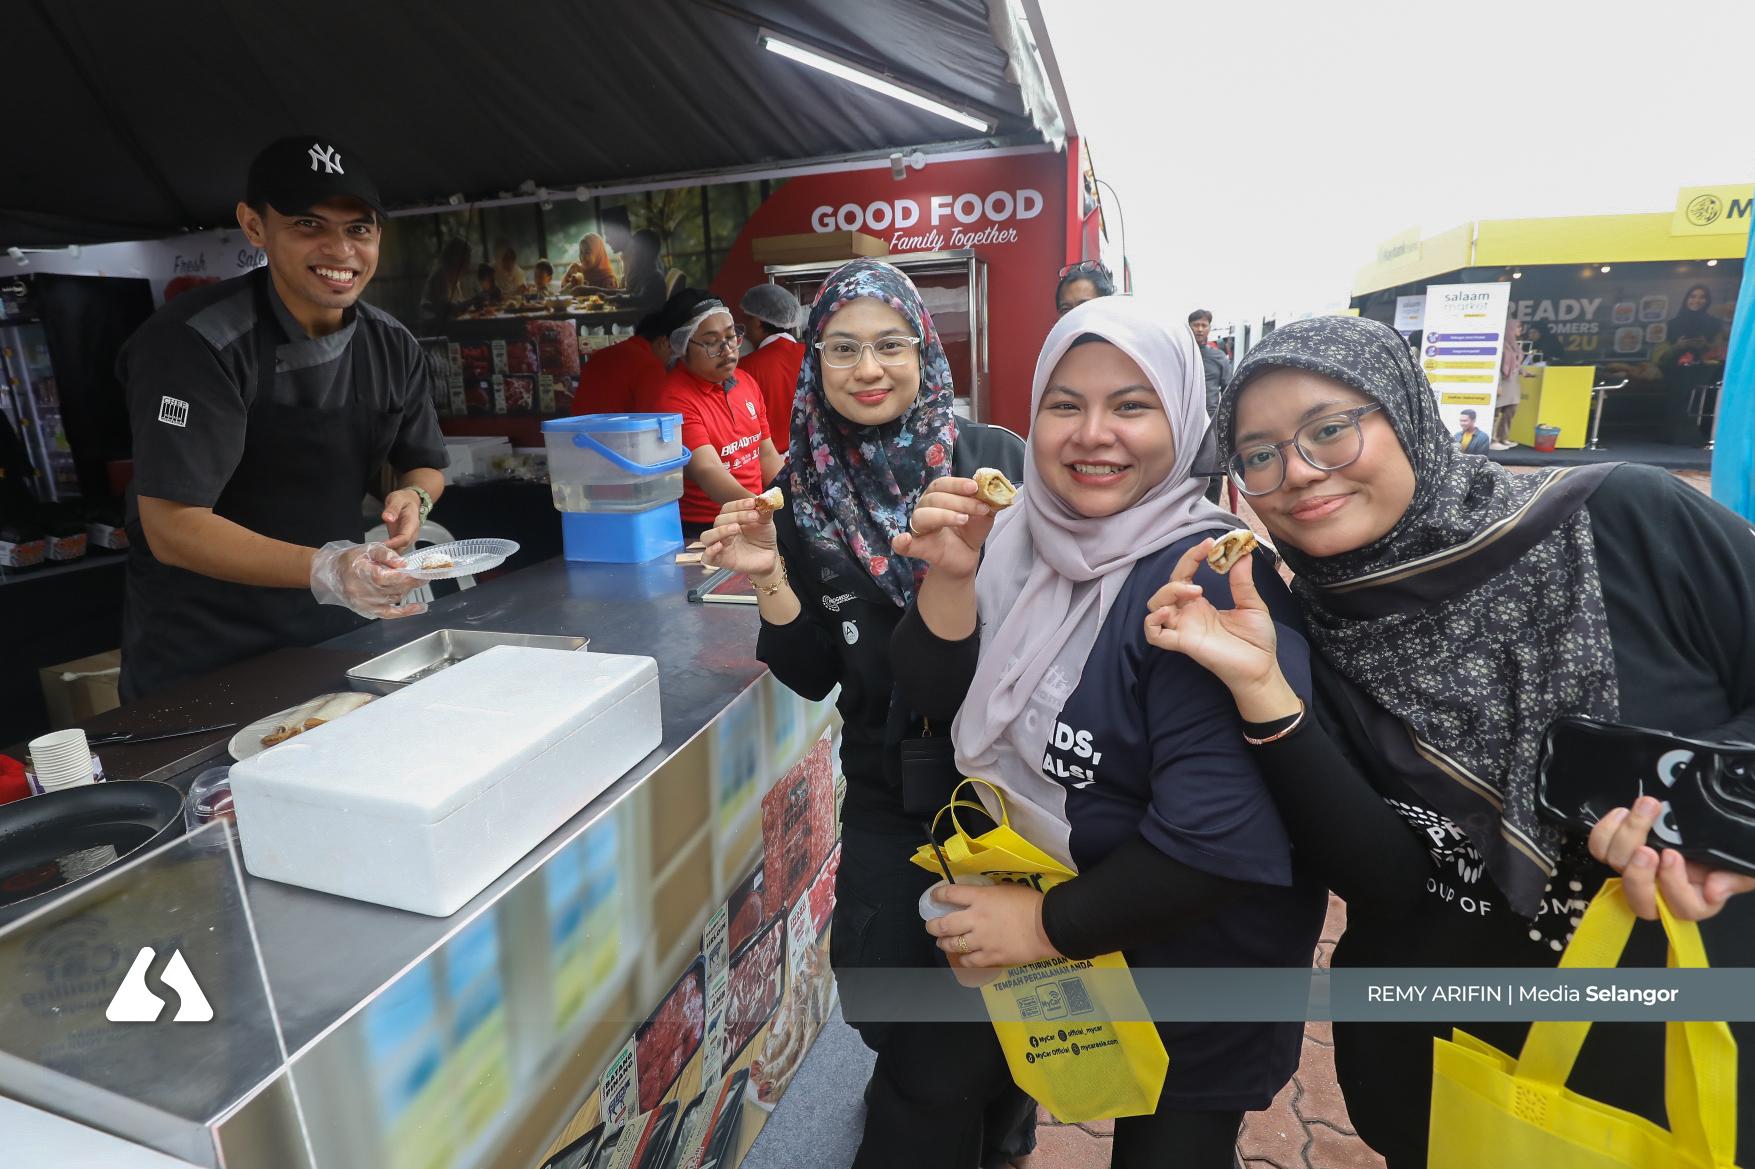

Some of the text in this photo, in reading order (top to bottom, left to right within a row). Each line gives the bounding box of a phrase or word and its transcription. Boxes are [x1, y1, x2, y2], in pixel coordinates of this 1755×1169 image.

[307, 143, 345, 175] NY
[811, 189, 1044, 233] GOOD FOOD
[890, 224, 1018, 252] Family Together
[173, 250, 207, 274] Fresh
[236, 247, 268, 268] Safe
[1444, 291, 1490, 302] salaam
[1460, 896, 1492, 916] OF
[993, 960, 1094, 992] TEMPAH PERJALANAN ANDA
[1008, 955, 1069, 978] MUAT TURUN DAN
[1038, 1034, 1055, 1044] MyCar
[1080, 1038, 1120, 1051] mycarasia.com
[1035, 1046, 1070, 1060] MyCar Official
[604, 1051, 633, 1090] BATANG
[605, 1060, 634, 1098] PINANG
